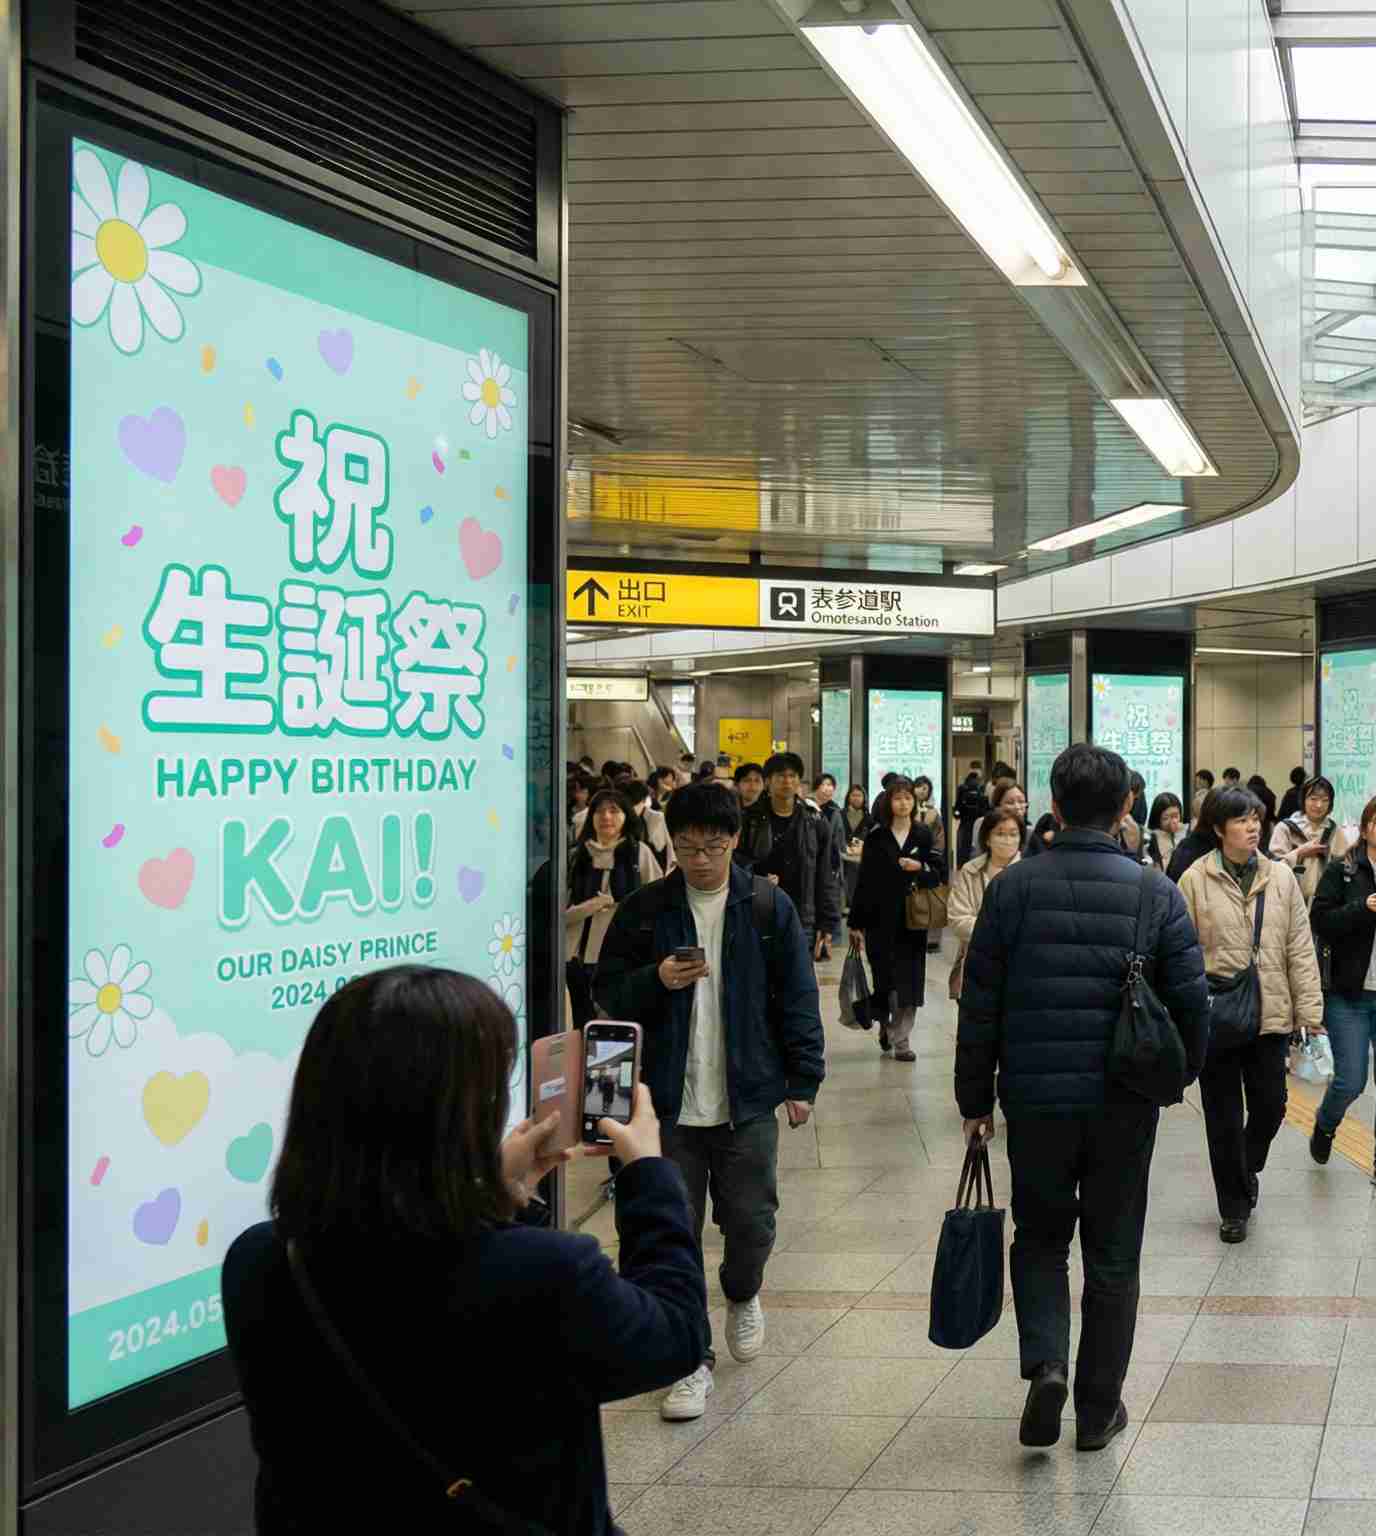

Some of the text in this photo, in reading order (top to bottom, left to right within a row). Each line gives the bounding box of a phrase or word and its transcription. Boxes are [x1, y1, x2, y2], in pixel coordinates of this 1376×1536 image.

[274, 409, 393, 578] 祝
[617, 578, 666, 603] 出口
[810, 588, 902, 612] 表参道駅
[618, 604, 651, 618] EXIT
[811, 611, 939, 629] Omotesando Station
[142, 564, 486, 740] 生誕祭
[155, 757, 478, 799] HAPPY BIRTHDAY
[216, 812, 437, 928] KAI!
[216, 931, 438, 982] OUR DAISY PRINCE
[271, 975, 360, 1010] 2024.0
